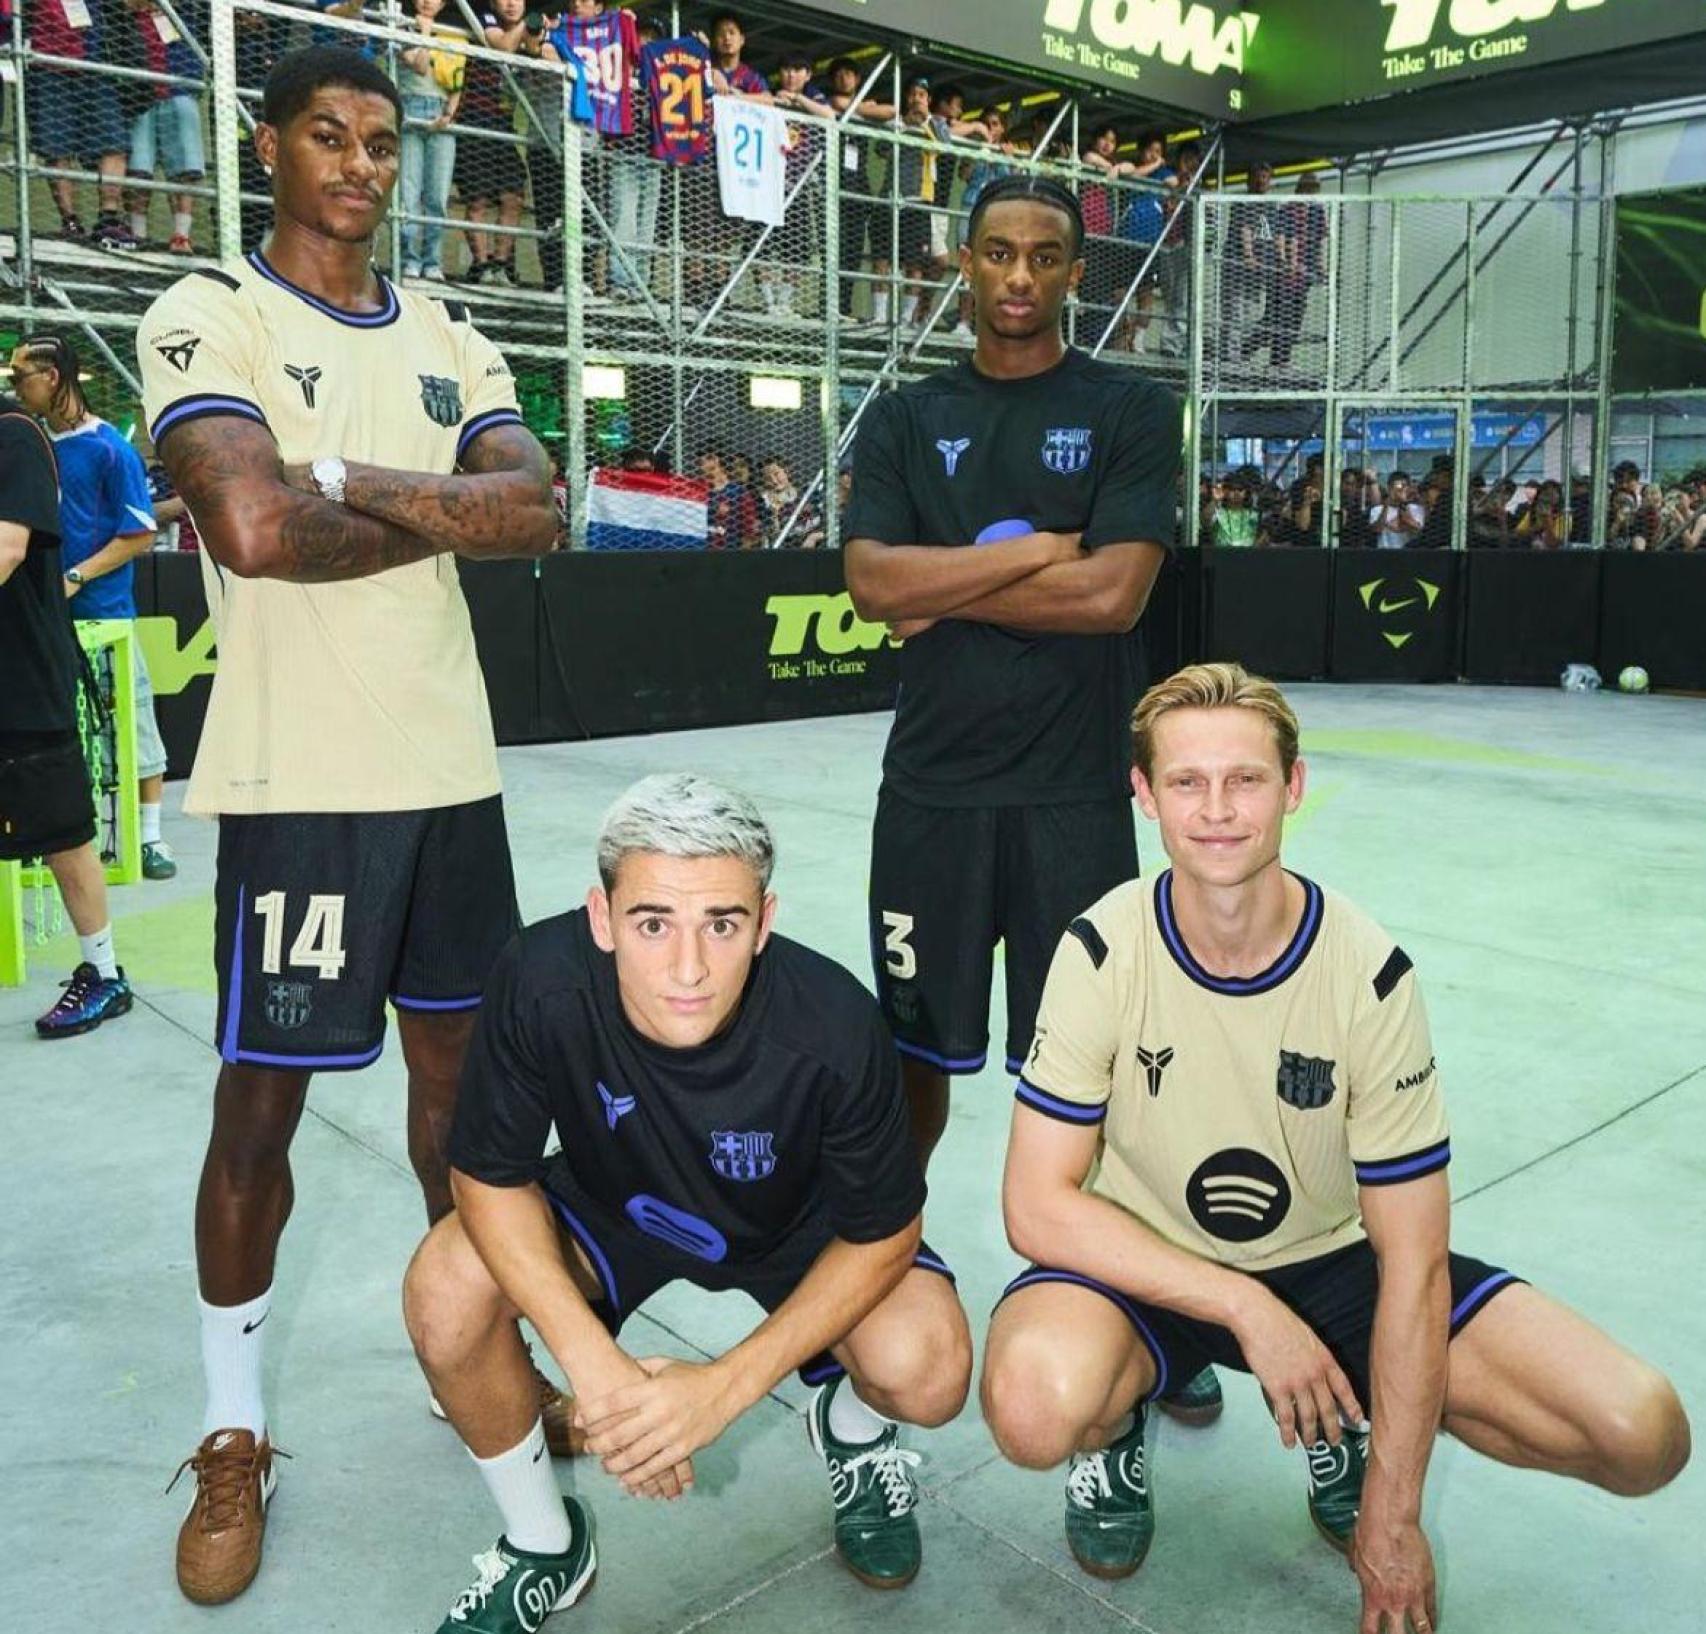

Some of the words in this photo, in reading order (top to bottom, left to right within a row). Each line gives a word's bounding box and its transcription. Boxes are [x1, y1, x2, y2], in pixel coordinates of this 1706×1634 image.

[573, 43, 622, 93] 30
[1042, 32, 1075, 61] Take
[1078, 43, 1101, 68] The
[1103, 51, 1140, 79] Game
[1382, 53, 1425, 79] Take
[1430, 46, 1464, 70] The
[1469, 35, 1528, 61] Game
[660, 73, 703, 124] 21
[735, 123, 762, 171] 21
[768, 661, 800, 680] Take
[803, 660, 826, 677] The
[829, 658, 866, 674] Game
[254, 890, 346, 980] 14
[883, 910, 916, 980] 3
[1307, 1440, 1337, 1474] 90
[525, 1576, 556, 1622] 90
